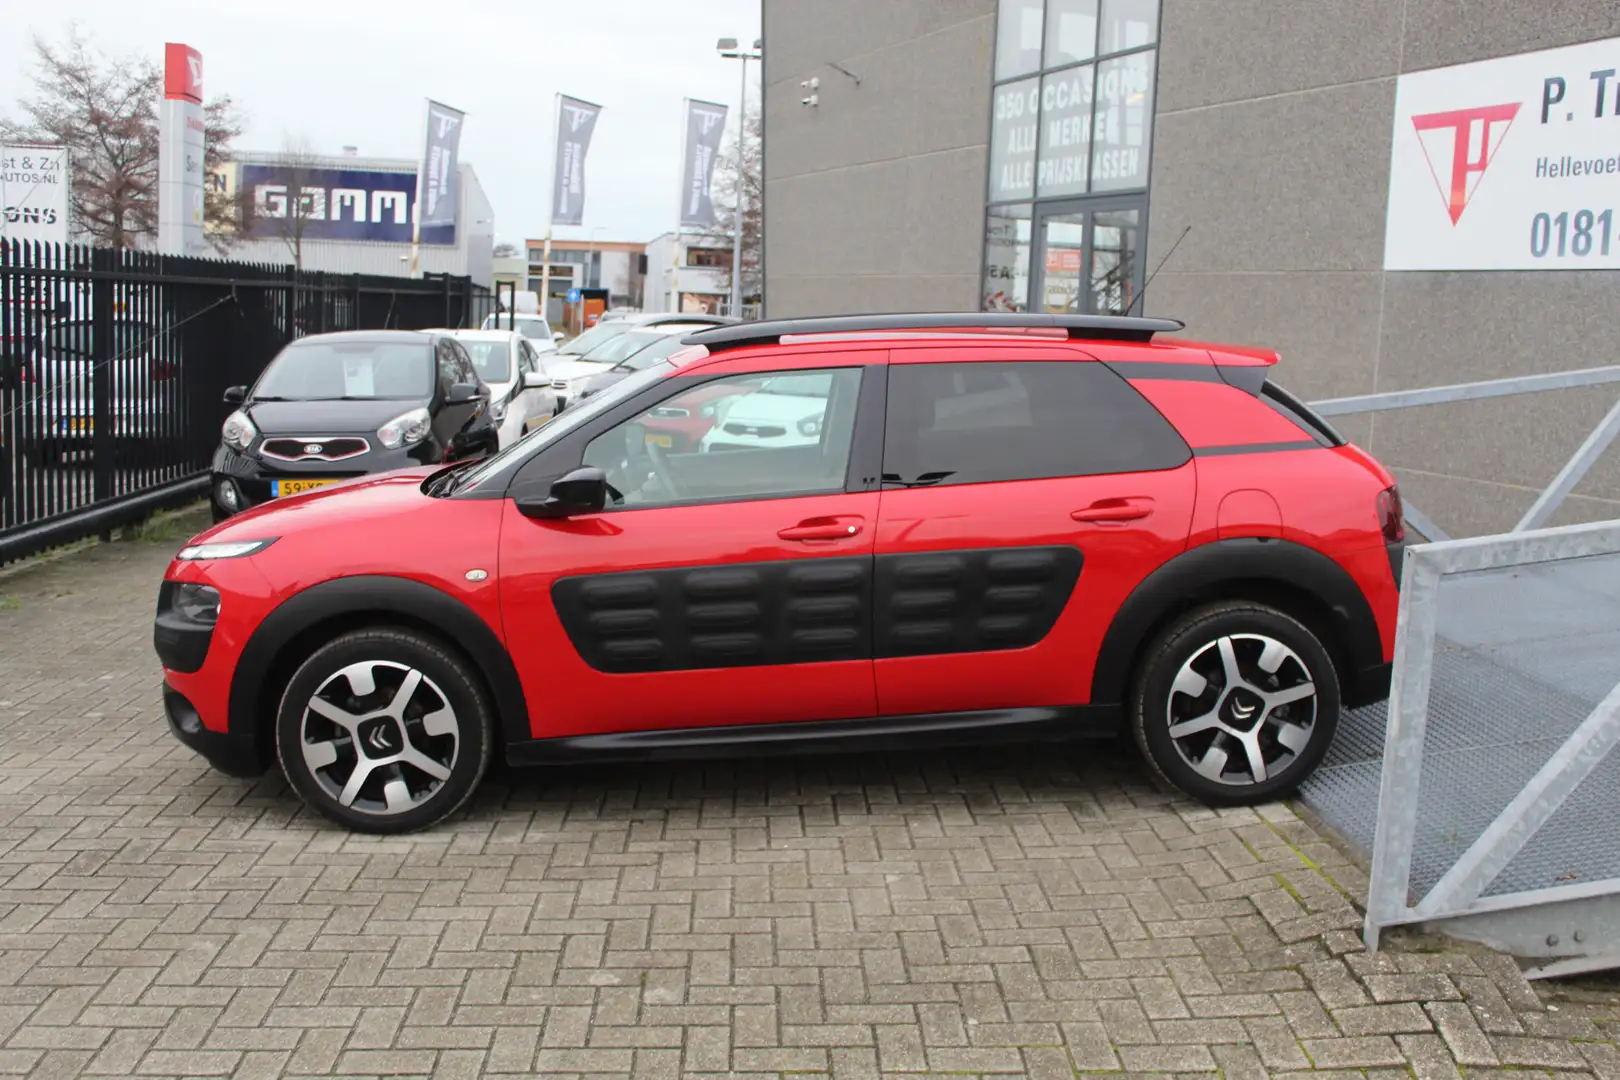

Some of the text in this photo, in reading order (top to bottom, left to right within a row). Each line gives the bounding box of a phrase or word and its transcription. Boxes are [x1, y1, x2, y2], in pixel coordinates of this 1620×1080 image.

[1589, 68, 1620, 118] T
[1049, 111, 1118, 148] MERKE
[22, 156, 33, 169] &
[1000, 161, 1032, 190] ALLE
[254, 184, 417, 225] GAMM
[1530, 208, 1620, 258] 0181
